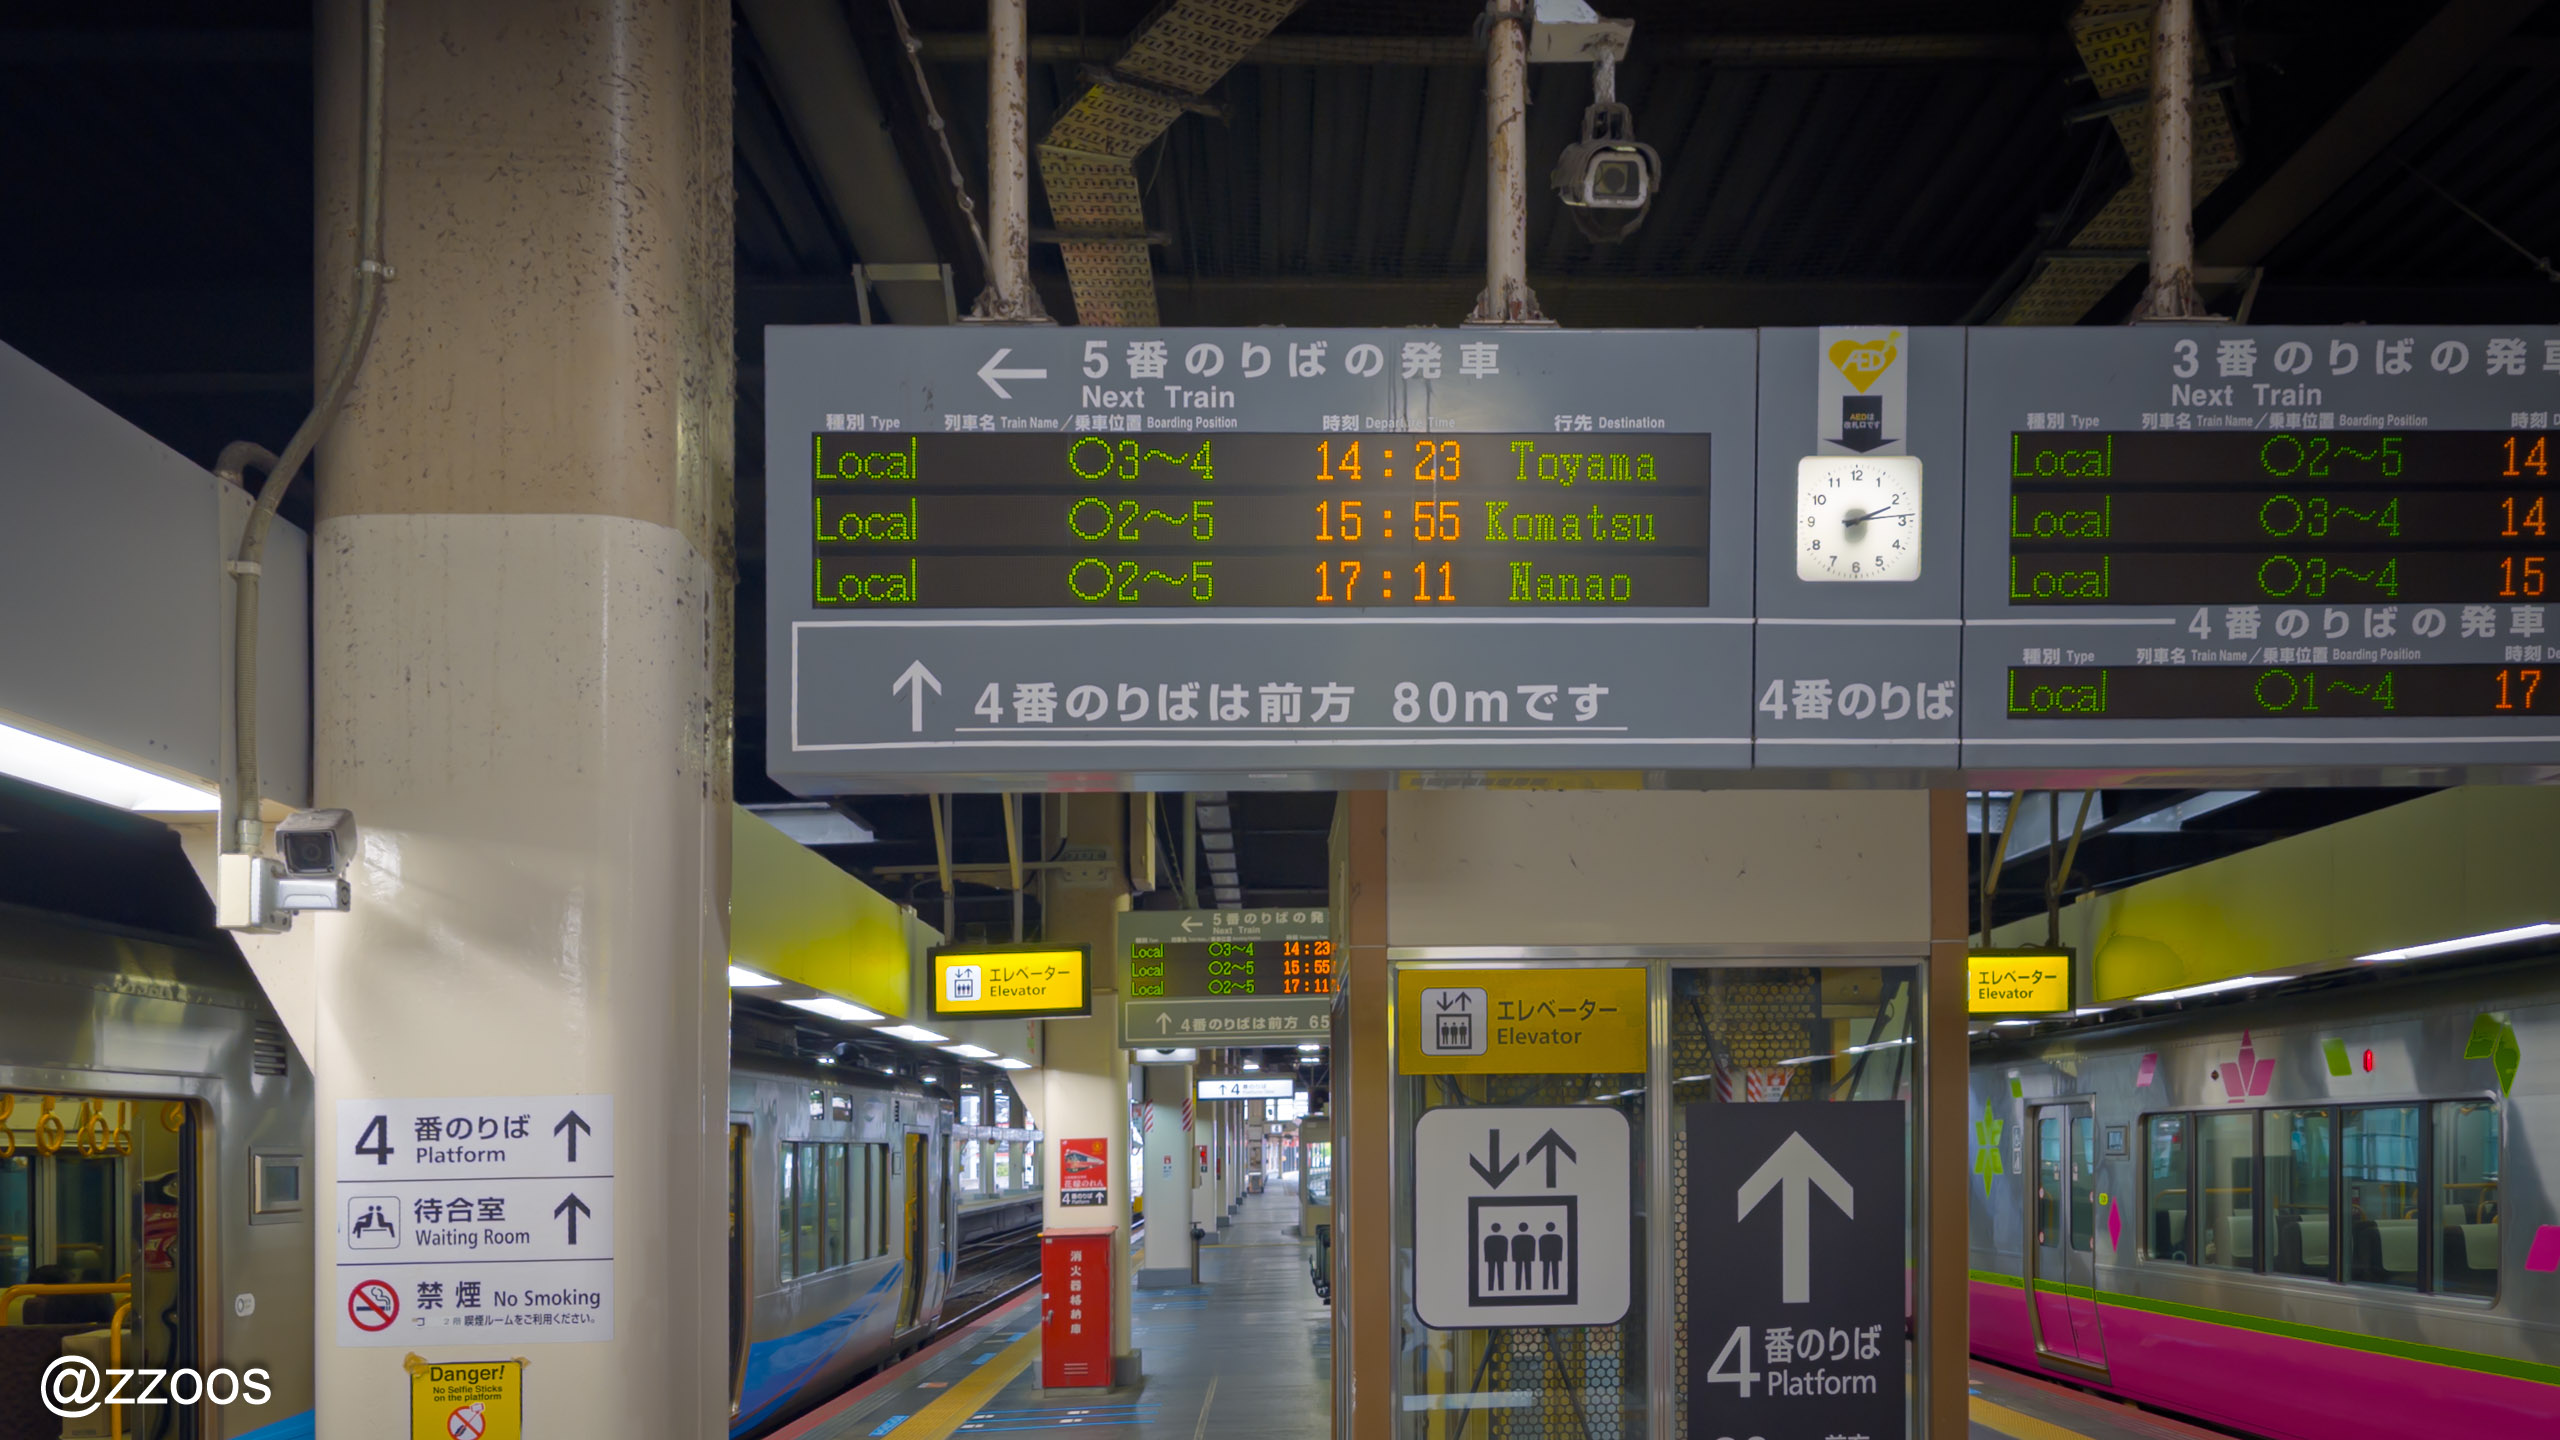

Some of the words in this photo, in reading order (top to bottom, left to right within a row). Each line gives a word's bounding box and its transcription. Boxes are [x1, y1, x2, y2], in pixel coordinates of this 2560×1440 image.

[1083, 340, 1499, 379] 5番のりばの発車
[1083, 385, 1145, 408] Next
[1165, 385, 1235, 408] Train
[2172, 384, 2233, 406] Next
[2252, 383, 2322, 406] Train
[826, 414, 865, 431] 種別
[871, 416, 900, 431] Type
[944, 414, 995, 431] 列車名
[1001, 416, 1027, 429] Train
[1030, 416, 1058, 429] Name
[1147, 416, 1193, 431] Boarding
[1196, 416, 1237, 429] Position
[1323, 414, 1359, 431] 時刻
[1427, 416, 1456, 429] Time
[1554, 414, 1592, 431] 行先
[1599, 416, 1665, 429] Destination
[2027, 413, 2064, 430] 種別
[2071, 414, 2100, 430] Type
[2142, 413, 2191, 430] 列車名
[2197, 414, 2222, 427] Train
[2225, 414, 2253, 427] Name
[2339, 414, 2384, 429] Boarding
[2387, 414, 2428, 427] Position
[2511, 411, 2547, 429] 時刻
[816, 436, 917, 480] Local
[1510, 440, 1657, 487] Toyama
[2013, 434, 2112, 477] Local
[2502, 437, 2547, 476] 14
[1828, 477, 1841, 488] 11
[1851, 470, 1863, 481] 12
[1876, 477, 1881, 487] 1
[1812, 494, 1827, 505] 10
[1892, 494, 1900, 505] 2
[816, 497, 917, 541] Local
[1484, 501, 1656, 542] Komatsu
[1807, 516, 1815, 527] 9
[1898, 515, 1907, 527] 3
[2012, 495, 2111, 538] Local
[2501, 497, 2546, 536] 14
[1812, 539, 1821, 551] 8
[1892, 539, 1900, 549] 4
[1829, 555, 1837, 567] 7
[1852, 562, 1860, 573] 6
[1875, 555, 1884, 567] 5
[816, 558, 917, 602] Local
[1509, 561, 1632, 602] Nanao
[2011, 555, 2109, 598] Local
[2499, 557, 2545, 596] 15
[2188, 605, 2545, 640] 4番のりばの発車
[2023, 648, 2060, 665] 種別
[2066, 650, 2095, 665] Type
[2137, 648, 2186, 664] 列車名
[2191, 649, 2217, 662] Train
[2219, 649, 2247, 662] Name
[2333, 649, 2378, 663] Boarding
[2380, 648, 2421, 660] Position
[2505, 645, 2542, 662] 時刻
[1759, 679, 1955, 720] 4番のりば
[2009, 670, 2107, 712] Local
[2496, 670, 2541, 709] 17
[974, 682, 1355, 724] 4番のりばは前方
[1393, 681, 1609, 723] 80mです
[1213, 926, 1233, 935] Next
[1238, 926, 1261, 934] Train
[1131, 943, 1164, 958] Local
[990, 966, 1070, 982] エレベーター
[1131, 962, 1164, 977] Local
[1979, 969, 2057, 985] エレベーター
[990, 985, 1046, 997] Elevator
[1131, 981, 1164, 996] Local
[1979, 988, 2033, 999] Elevator
[1497, 999, 1618, 1021] エレベーター
[1498, 1027, 1582, 1045] Elevator
[1231, 1083, 1240, 1095] 4
[355, 1115, 394, 1165] 4
[414, 1113, 530, 1142] 番のりば
[416, 1146, 505, 1163] Platform
[414, 1197, 506, 1224] 待合室
[416, 1229, 478, 1249] Waiting
[484, 1229, 530, 1244] Room
[494, 1291, 518, 1307] No
[525, 1289, 601, 1308] Smoking
[1707, 1326, 1761, 1398] 4
[1765, 1324, 1882, 1364] 番のりば
[430, 1365, 505, 1384] Danger!
[1769, 1368, 1877, 1396] Platform
[433, 1386, 445, 1394] No
[448, 1385, 473, 1394] Selfie
[475, 1384, 503, 1393] Sticks
[464, 1393, 502, 1403] platform
